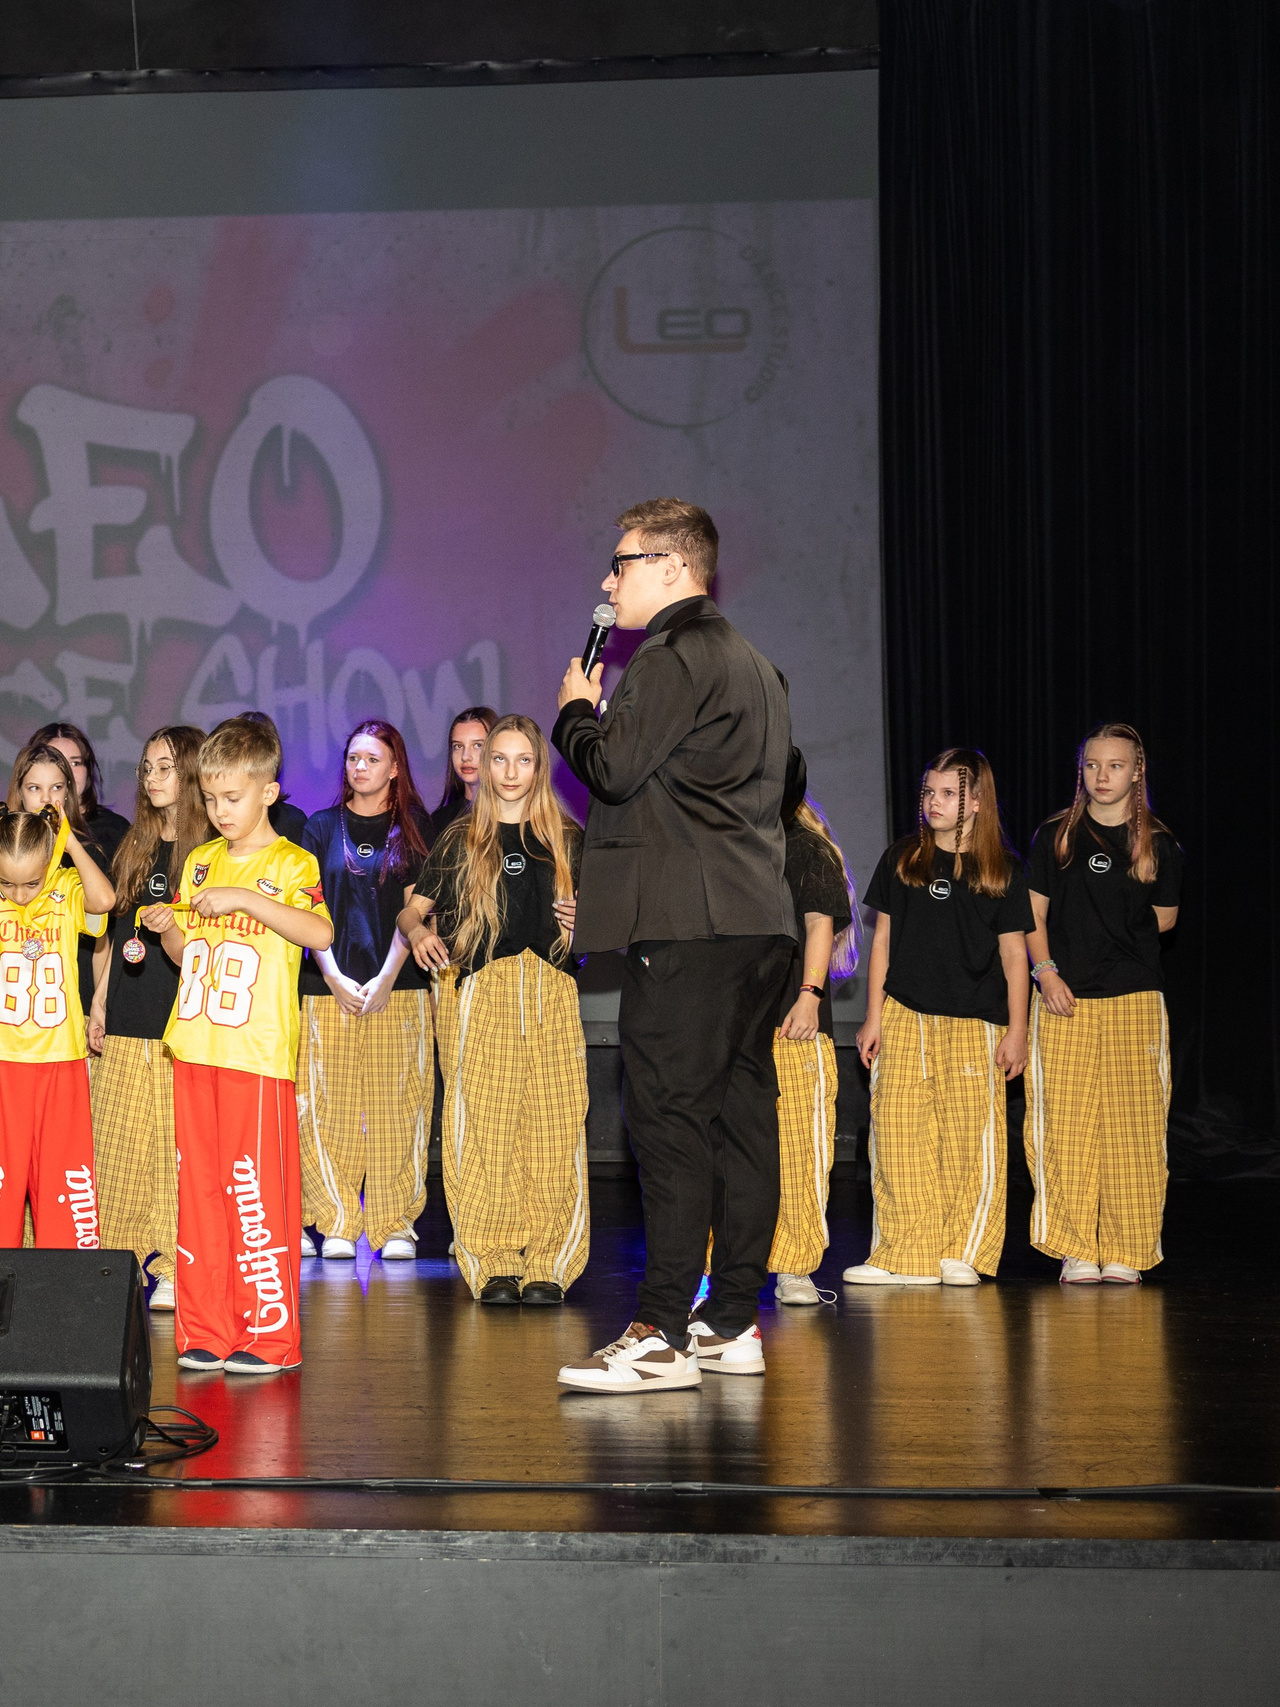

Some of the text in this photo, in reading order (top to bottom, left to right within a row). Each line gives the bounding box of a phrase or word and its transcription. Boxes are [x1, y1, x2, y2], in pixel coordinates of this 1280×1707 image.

[613, 285, 753, 355] LEO
[177, 937, 261, 1029] 88
[226, 1154, 289, 1334] California
